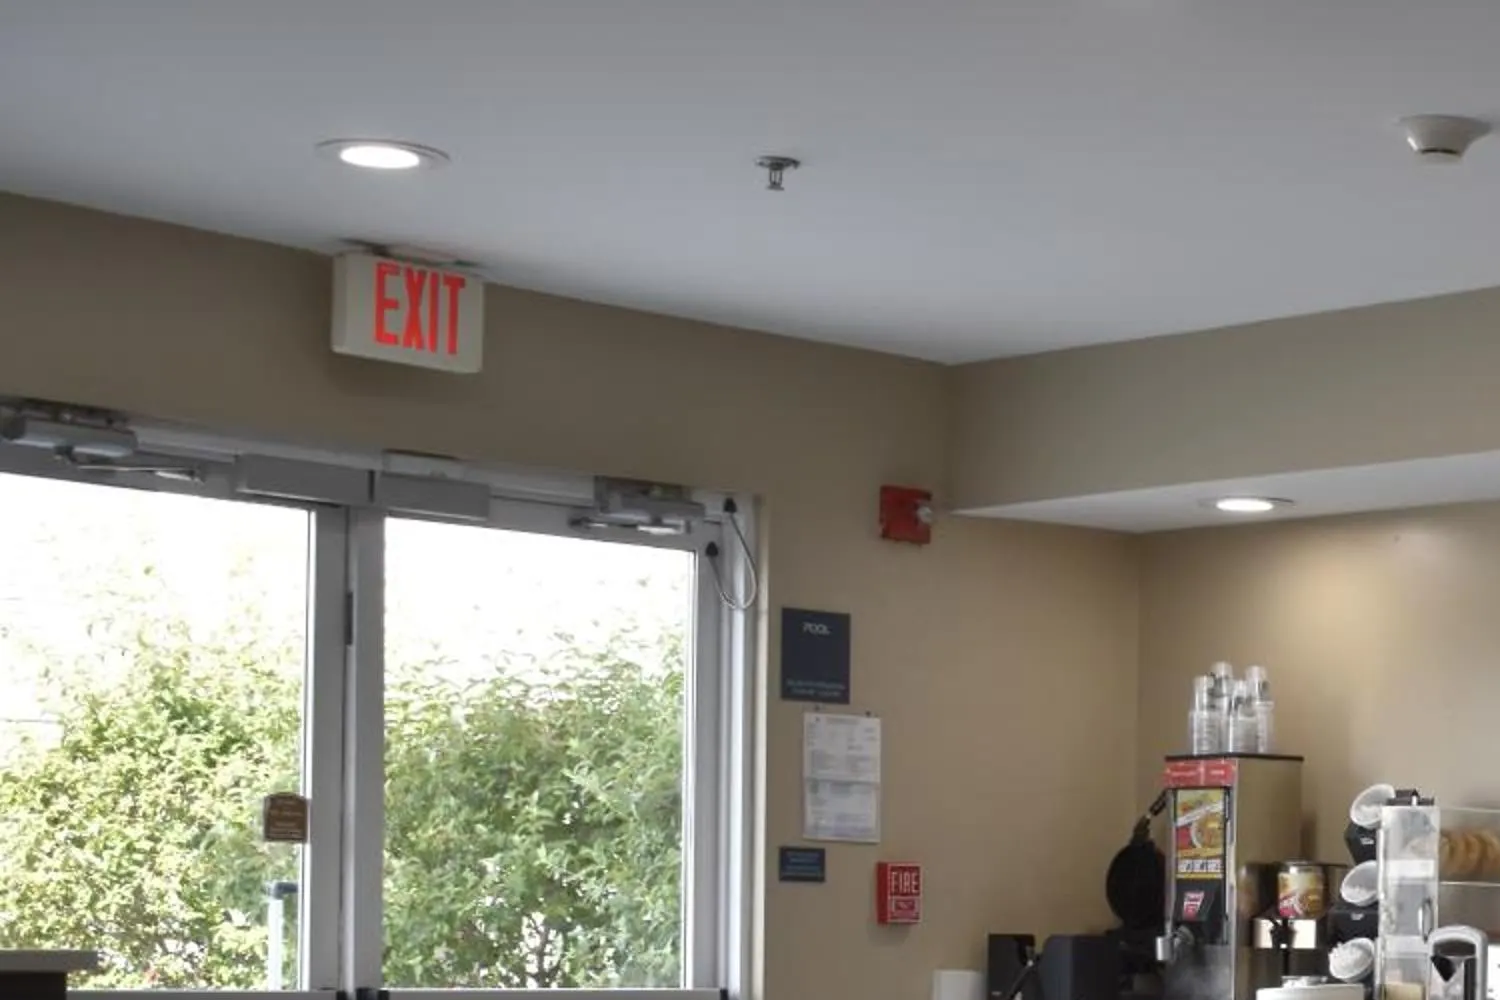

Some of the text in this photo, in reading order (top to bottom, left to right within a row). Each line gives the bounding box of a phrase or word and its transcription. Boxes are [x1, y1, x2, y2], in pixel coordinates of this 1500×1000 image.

[373, 261, 466, 356] EXIT
[802, 621, 831, 636] POOL
[891, 870, 920, 894] FIRE
